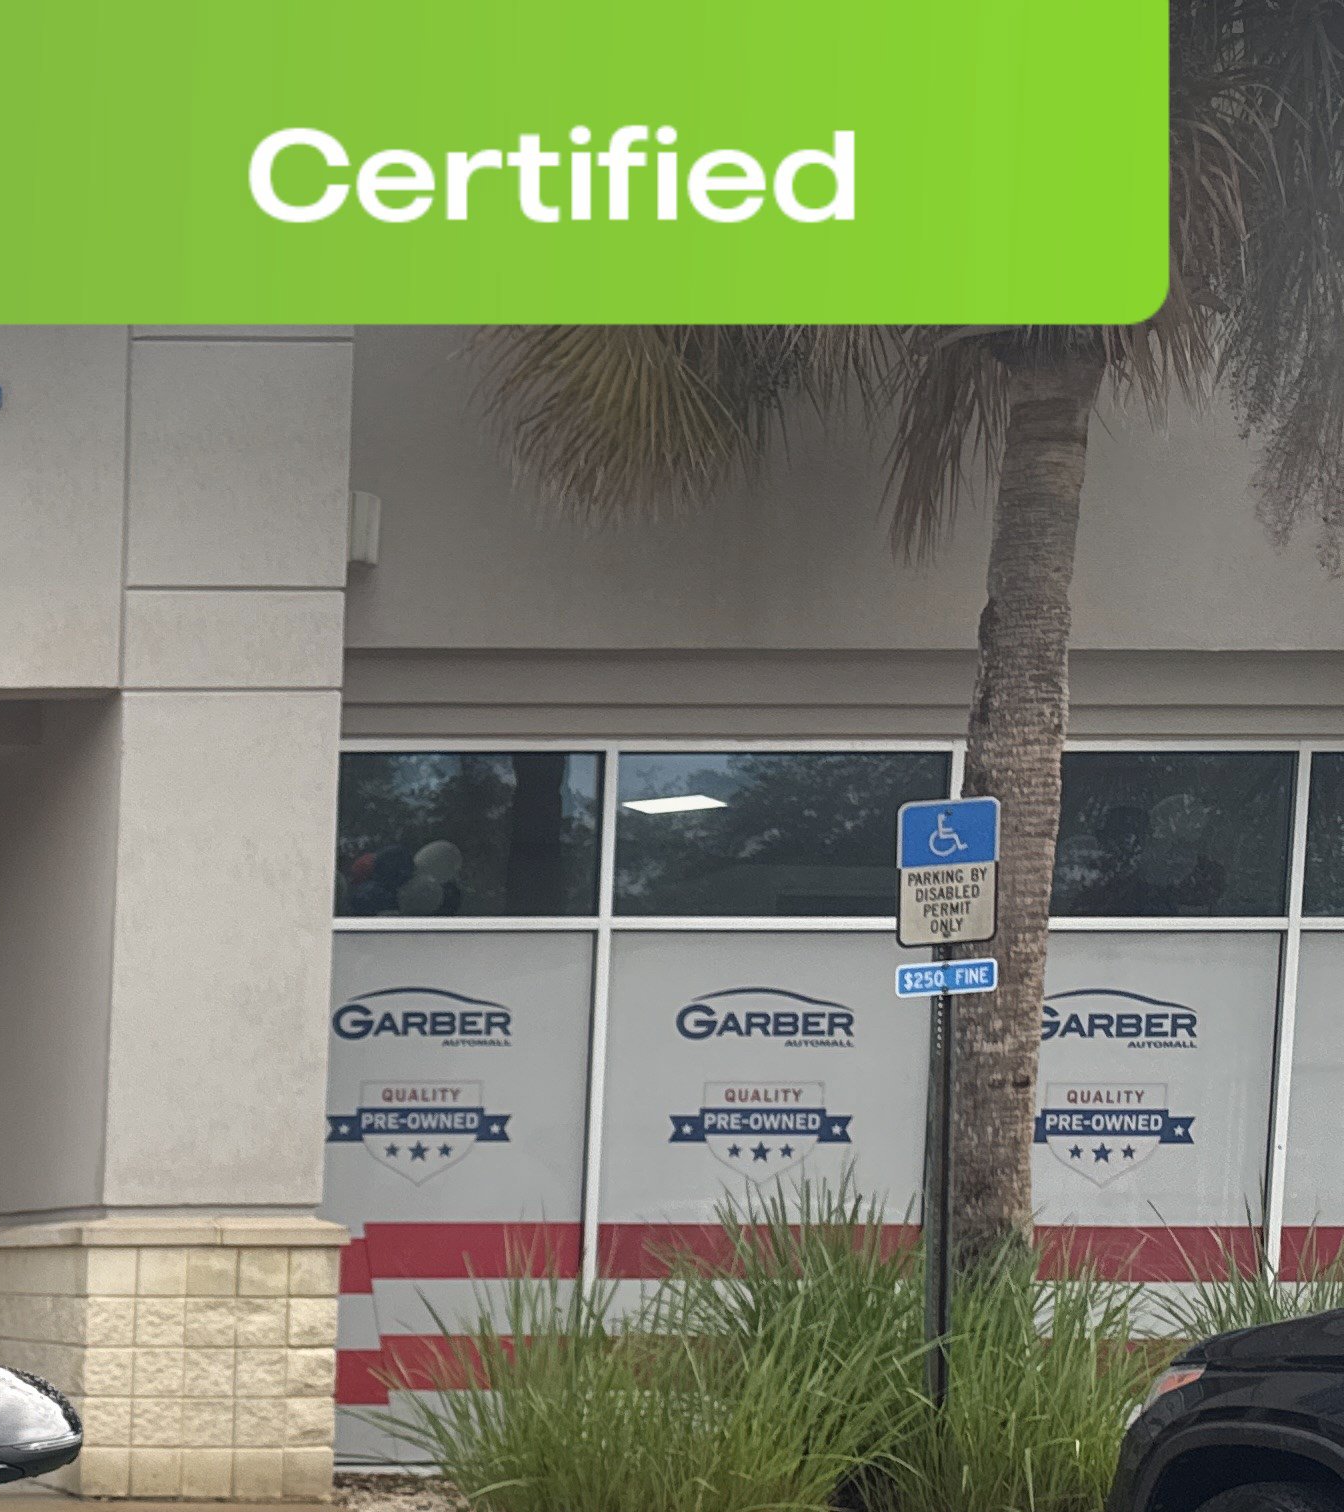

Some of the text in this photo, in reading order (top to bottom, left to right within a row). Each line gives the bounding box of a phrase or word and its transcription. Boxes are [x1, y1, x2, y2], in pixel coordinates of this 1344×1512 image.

[908, 867, 988, 887] PARKING BY
[915, 884, 981, 902] DISABLED
[923, 901, 971, 918] PERMIT
[930, 918, 963, 934] ONLY
[903, 966, 989, 990] $250 FINE
[332, 1004, 512, 1040] GARBER
[676, 1004, 854, 1040] GARBER
[441, 1039, 512, 1047] AUTOMALL
[784, 1040, 854, 1048] AUTOMALL
[381, 1088, 461, 1103] QUALITY
[724, 1088, 803, 1103] QUALITY
[1067, 1090, 1145, 1104] QUALITY
[362, 1112, 480, 1129] PRE-OWNED
[704, 1113, 821, 1130] PRE-OWNED
[1045, 1114, 1163, 1131] PRE-OWNED
